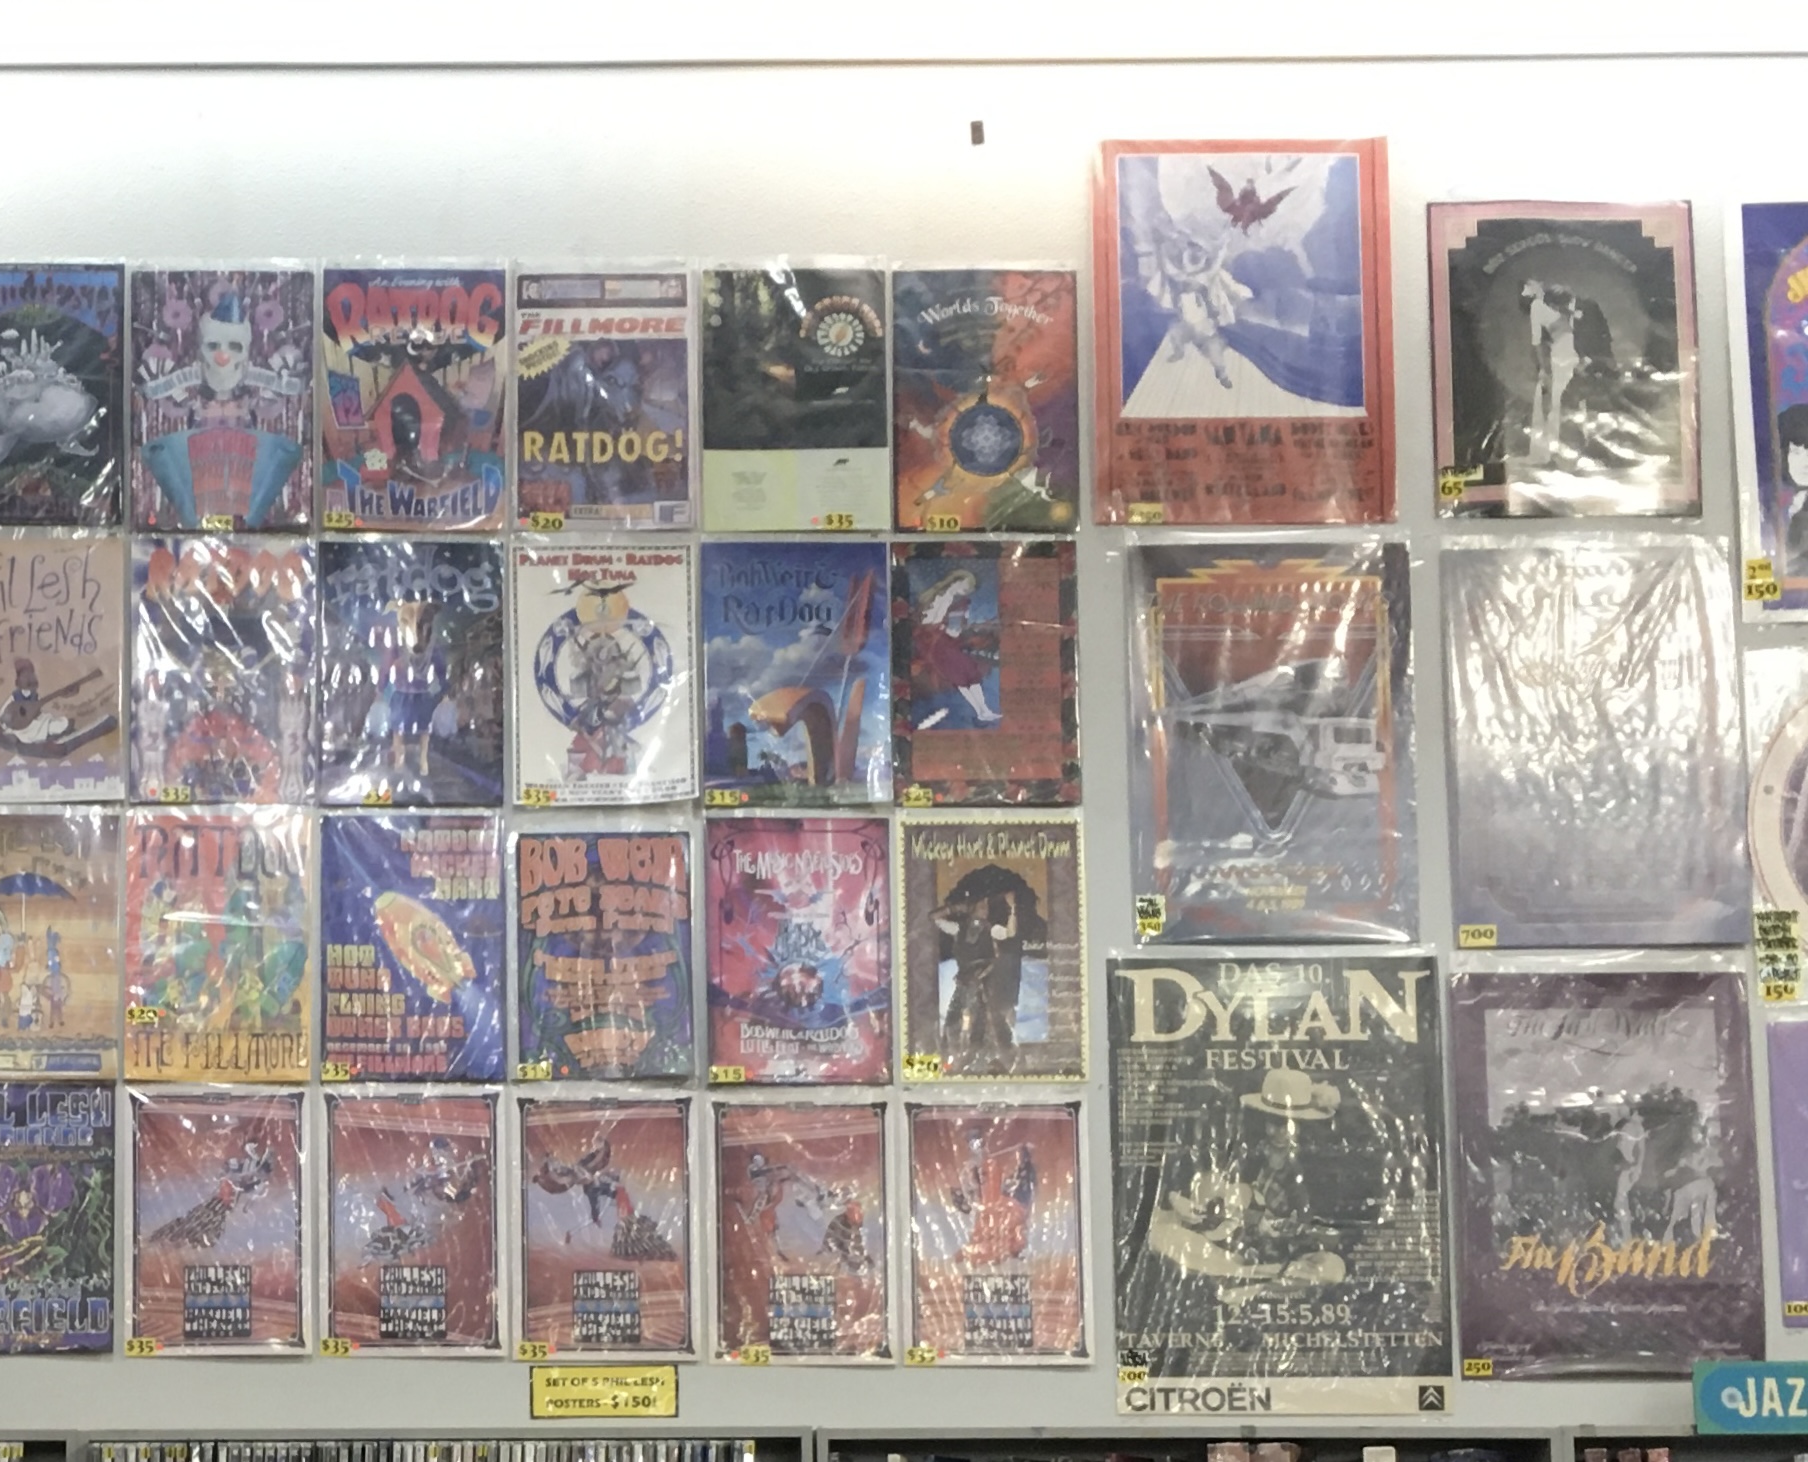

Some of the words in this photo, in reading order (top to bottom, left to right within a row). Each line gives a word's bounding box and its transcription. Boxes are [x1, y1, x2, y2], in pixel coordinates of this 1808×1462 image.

[519, 316, 686, 336] FILLMORE
[337, 459, 385, 516] THE
[387, 463, 503, 517] WARFIELD
[326, 513, 353, 526] $25
[531, 515, 563, 530] $20
[826, 514, 853, 528] $35
[928, 517, 958, 530] $10
[519, 554, 568, 566] PLANET
[572, 554, 613, 566] DRUM
[626, 554, 683, 566] RATDOG
[24, 546, 102, 614] Lesh
[1747, 582, 1777, 597] 150
[162, 786, 190, 801] $35
[707, 792, 738, 803] $15
[520, 838, 588, 897] BOB
[597, 837, 687, 892] WEIR
[1461, 926, 1495, 942] 700
[327, 944, 375, 967] HOT
[327, 968, 391, 990] TUNA
[1218, 962, 1281, 987] DAS
[1293, 962, 1330, 986] 10.
[1114, 967, 1431, 1044] DYLAN
[1205, 1048, 1350, 1071] FESTIVAL
[711, 1070, 742, 1081] $15
[26, 1091, 112, 1126] LESH
[1557, 1219, 1716, 1298] Band
[126, 1340, 154, 1353] $35
[322, 1339, 349, 1354] $35
[1124, 1330, 1224, 1349] TAVERNE
[1261, 1330, 1444, 1349] MICHELSTETTEN
[519, 1344, 548, 1357] $35
[1465, 1360, 1492, 1375] 250
[545, 1376, 568, 1387] SET
[570, 1376, 587, 1387] OF
[1125, 1381, 1273, 1412] CITROËN
